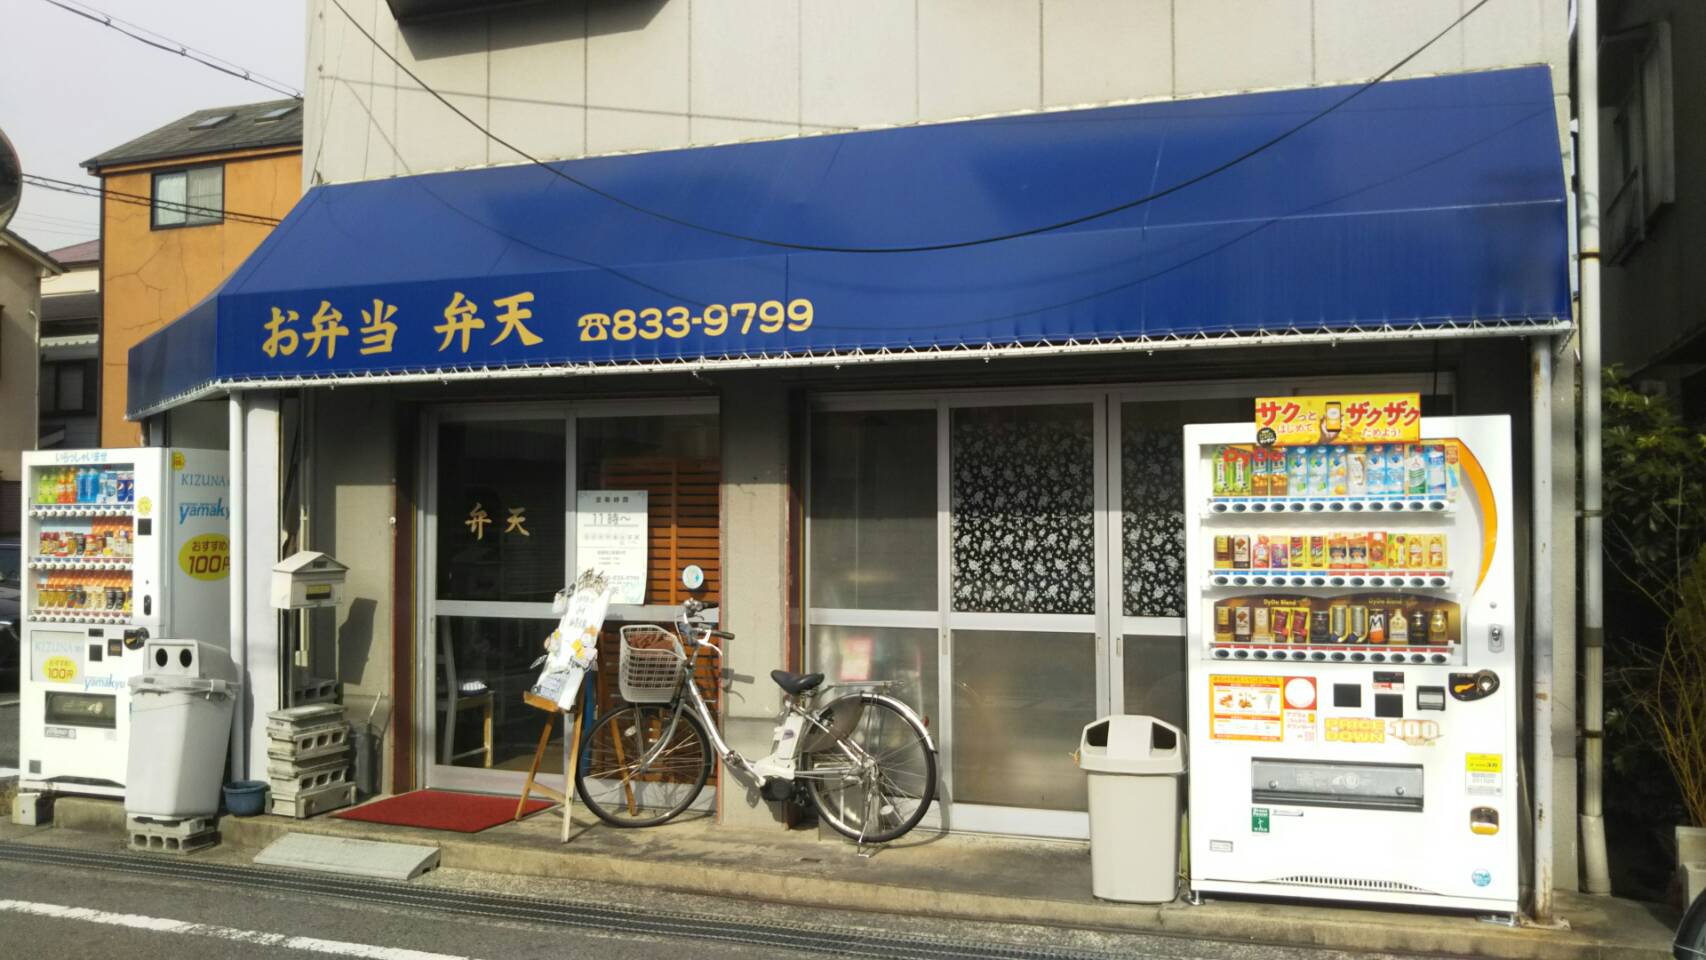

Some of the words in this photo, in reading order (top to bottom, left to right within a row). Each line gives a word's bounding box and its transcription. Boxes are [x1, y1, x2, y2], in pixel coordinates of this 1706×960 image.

[262, 298, 399, 360] お弁当
[433, 291, 544, 354] 弁天
[1255, 401, 1317, 427] サクっと
[1346, 400, 1420, 427] ザクザク
[180, 473, 225, 487] KIZUNA
[464, 501, 530, 541] 弁天
